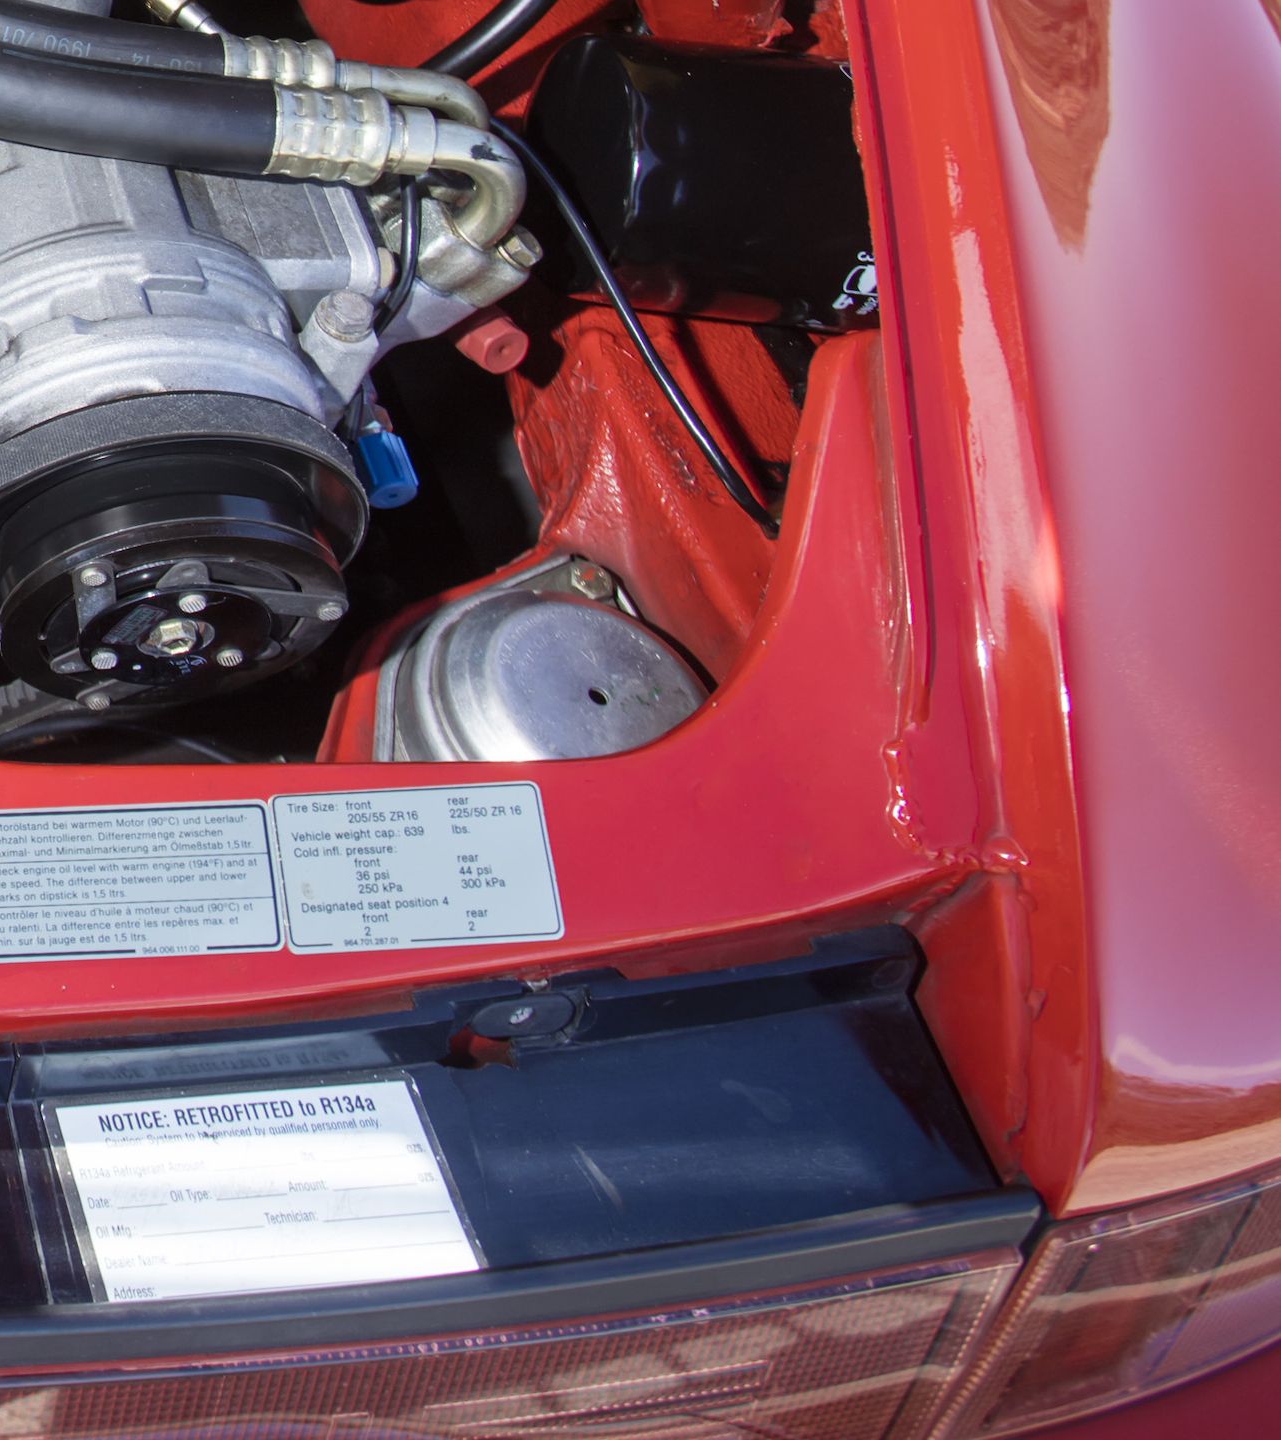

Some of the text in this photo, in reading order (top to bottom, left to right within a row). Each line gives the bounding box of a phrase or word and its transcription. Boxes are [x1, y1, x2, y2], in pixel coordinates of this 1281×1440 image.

[44, 34, 91, 56] 1990
[287, 803, 309, 814] Tire
[345, 800, 372, 811] front
[447, 797, 469, 806] rear
[52, 821, 68, 831] bei
[70, 821, 113, 830] warmem
[116, 818, 145, 828] Motor
[183, 816, 202, 826] und
[204, 814, 248, 825] Leerlauf-
[347, 812, 387, 824] 205/55
[449, 807, 488, 819] 225/50
[97, 831, 176, 842] Differenzmenge
[178, 828, 224, 839] zwischen
[291, 831, 332, 843] Vehicle
[335, 829, 372, 842] weight
[404, 826, 425, 837] 639
[34, 848, 53, 857] und
[56, 844, 149, 856] Minimalmarkierung
[152, 844, 168, 853] am
[293, 847, 320, 859] Cold
[23, 865, 57, 877] engine
[58, 864, 71, 874] oil
[73, 864, 97, 874] level
[98, 863, 120, 872] with
[122, 863, 150, 872] warm
[152, 862, 186, 872] engine
[226, 858, 245, 868] and
[247, 858, 258, 867] at
[354, 854, 479, 869] front rear
[10, 879, 43, 890] speed.
[46, 878, 65, 887] The
[121, 875, 164, 885] between
[166, 872, 195, 884] upper
[199, 872, 218, 882] and
[220, 872, 247, 881] lower
[356, 866, 493, 883] 36 psi 44 psi
[358, 877, 506, 895] 250 kPa 300 kPa
[23, 893, 37, 902] on
[39, 890, 79, 902] dipstick
[81, 891, 90, 900] is
[42, 910, 52, 919] le
[54, 910, 87, 918] niveau
[135, 906, 170, 916] moteur
[173, 904, 205, 914] chaud
[243, 902, 254, 912] et
[301, 896, 449, 915] Designated seat position 4
[45, 923, 58, 932] La
[114, 918, 141, 930] entre
[143, 919, 159, 928] les
[229, 916, 239, 925] et
[362, 909, 488, 924] front rear
[364, 920, 476, 937] 2 2
[18, 938, 34, 947] sur
[36, 936, 46, 946] la
[49, 936, 77, 947] jauge
[79, 935, 96, 944] est
[98, 934, 111, 944] de
[97, 1094, 377, 1133] NOTICE: RETROFITTED to R134a
[267, 1122, 310, 1137] qualified
[309, 1118, 359, 1133] personnel
[87, 1196, 114, 1211] Date:
[168, 1189, 186, 1203] Oil
[95, 1208, 320, 1239] Oil Technician:
[112, 1284, 158, 1301] Address:
